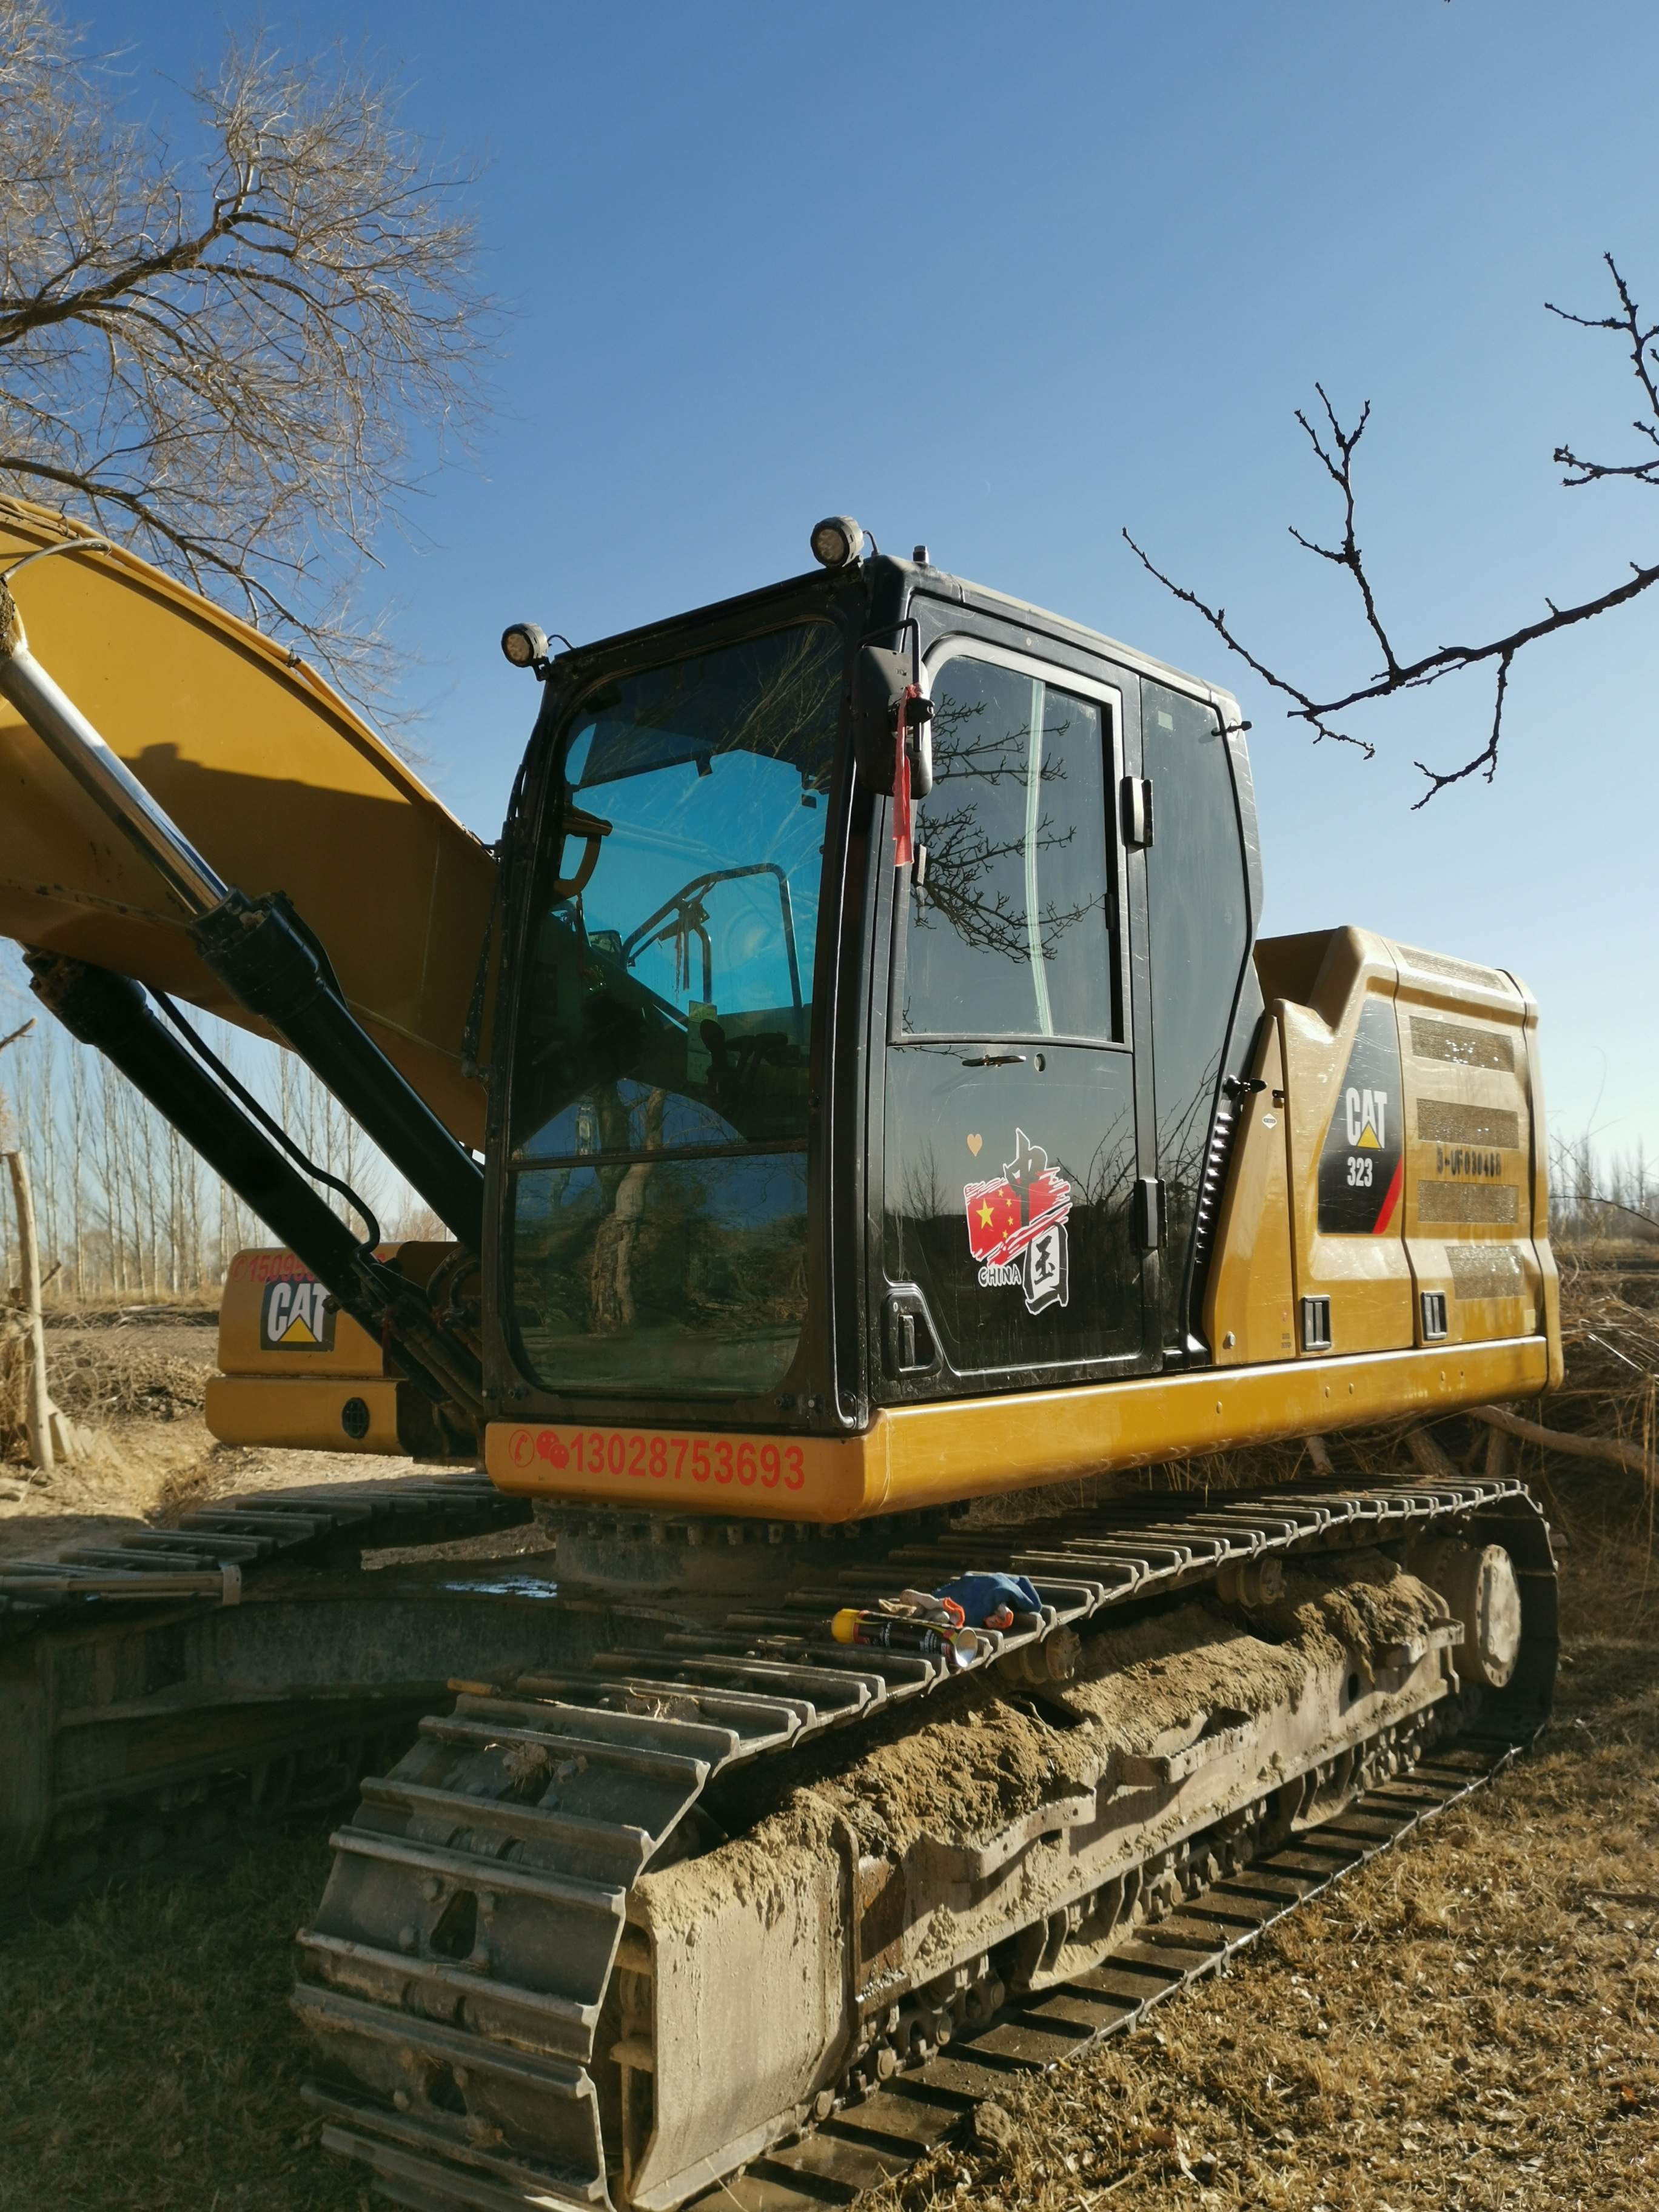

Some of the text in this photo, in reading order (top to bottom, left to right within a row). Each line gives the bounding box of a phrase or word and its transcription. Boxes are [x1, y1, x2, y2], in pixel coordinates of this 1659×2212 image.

[1346, 1087, 1387, 1149] CAT
[1347, 1156, 1373, 1187] 323
[978, 1264, 1022, 1287] CHINA
[267, 1282, 331, 1342] CAT
[570, 1432, 805, 1490] 13028753693
